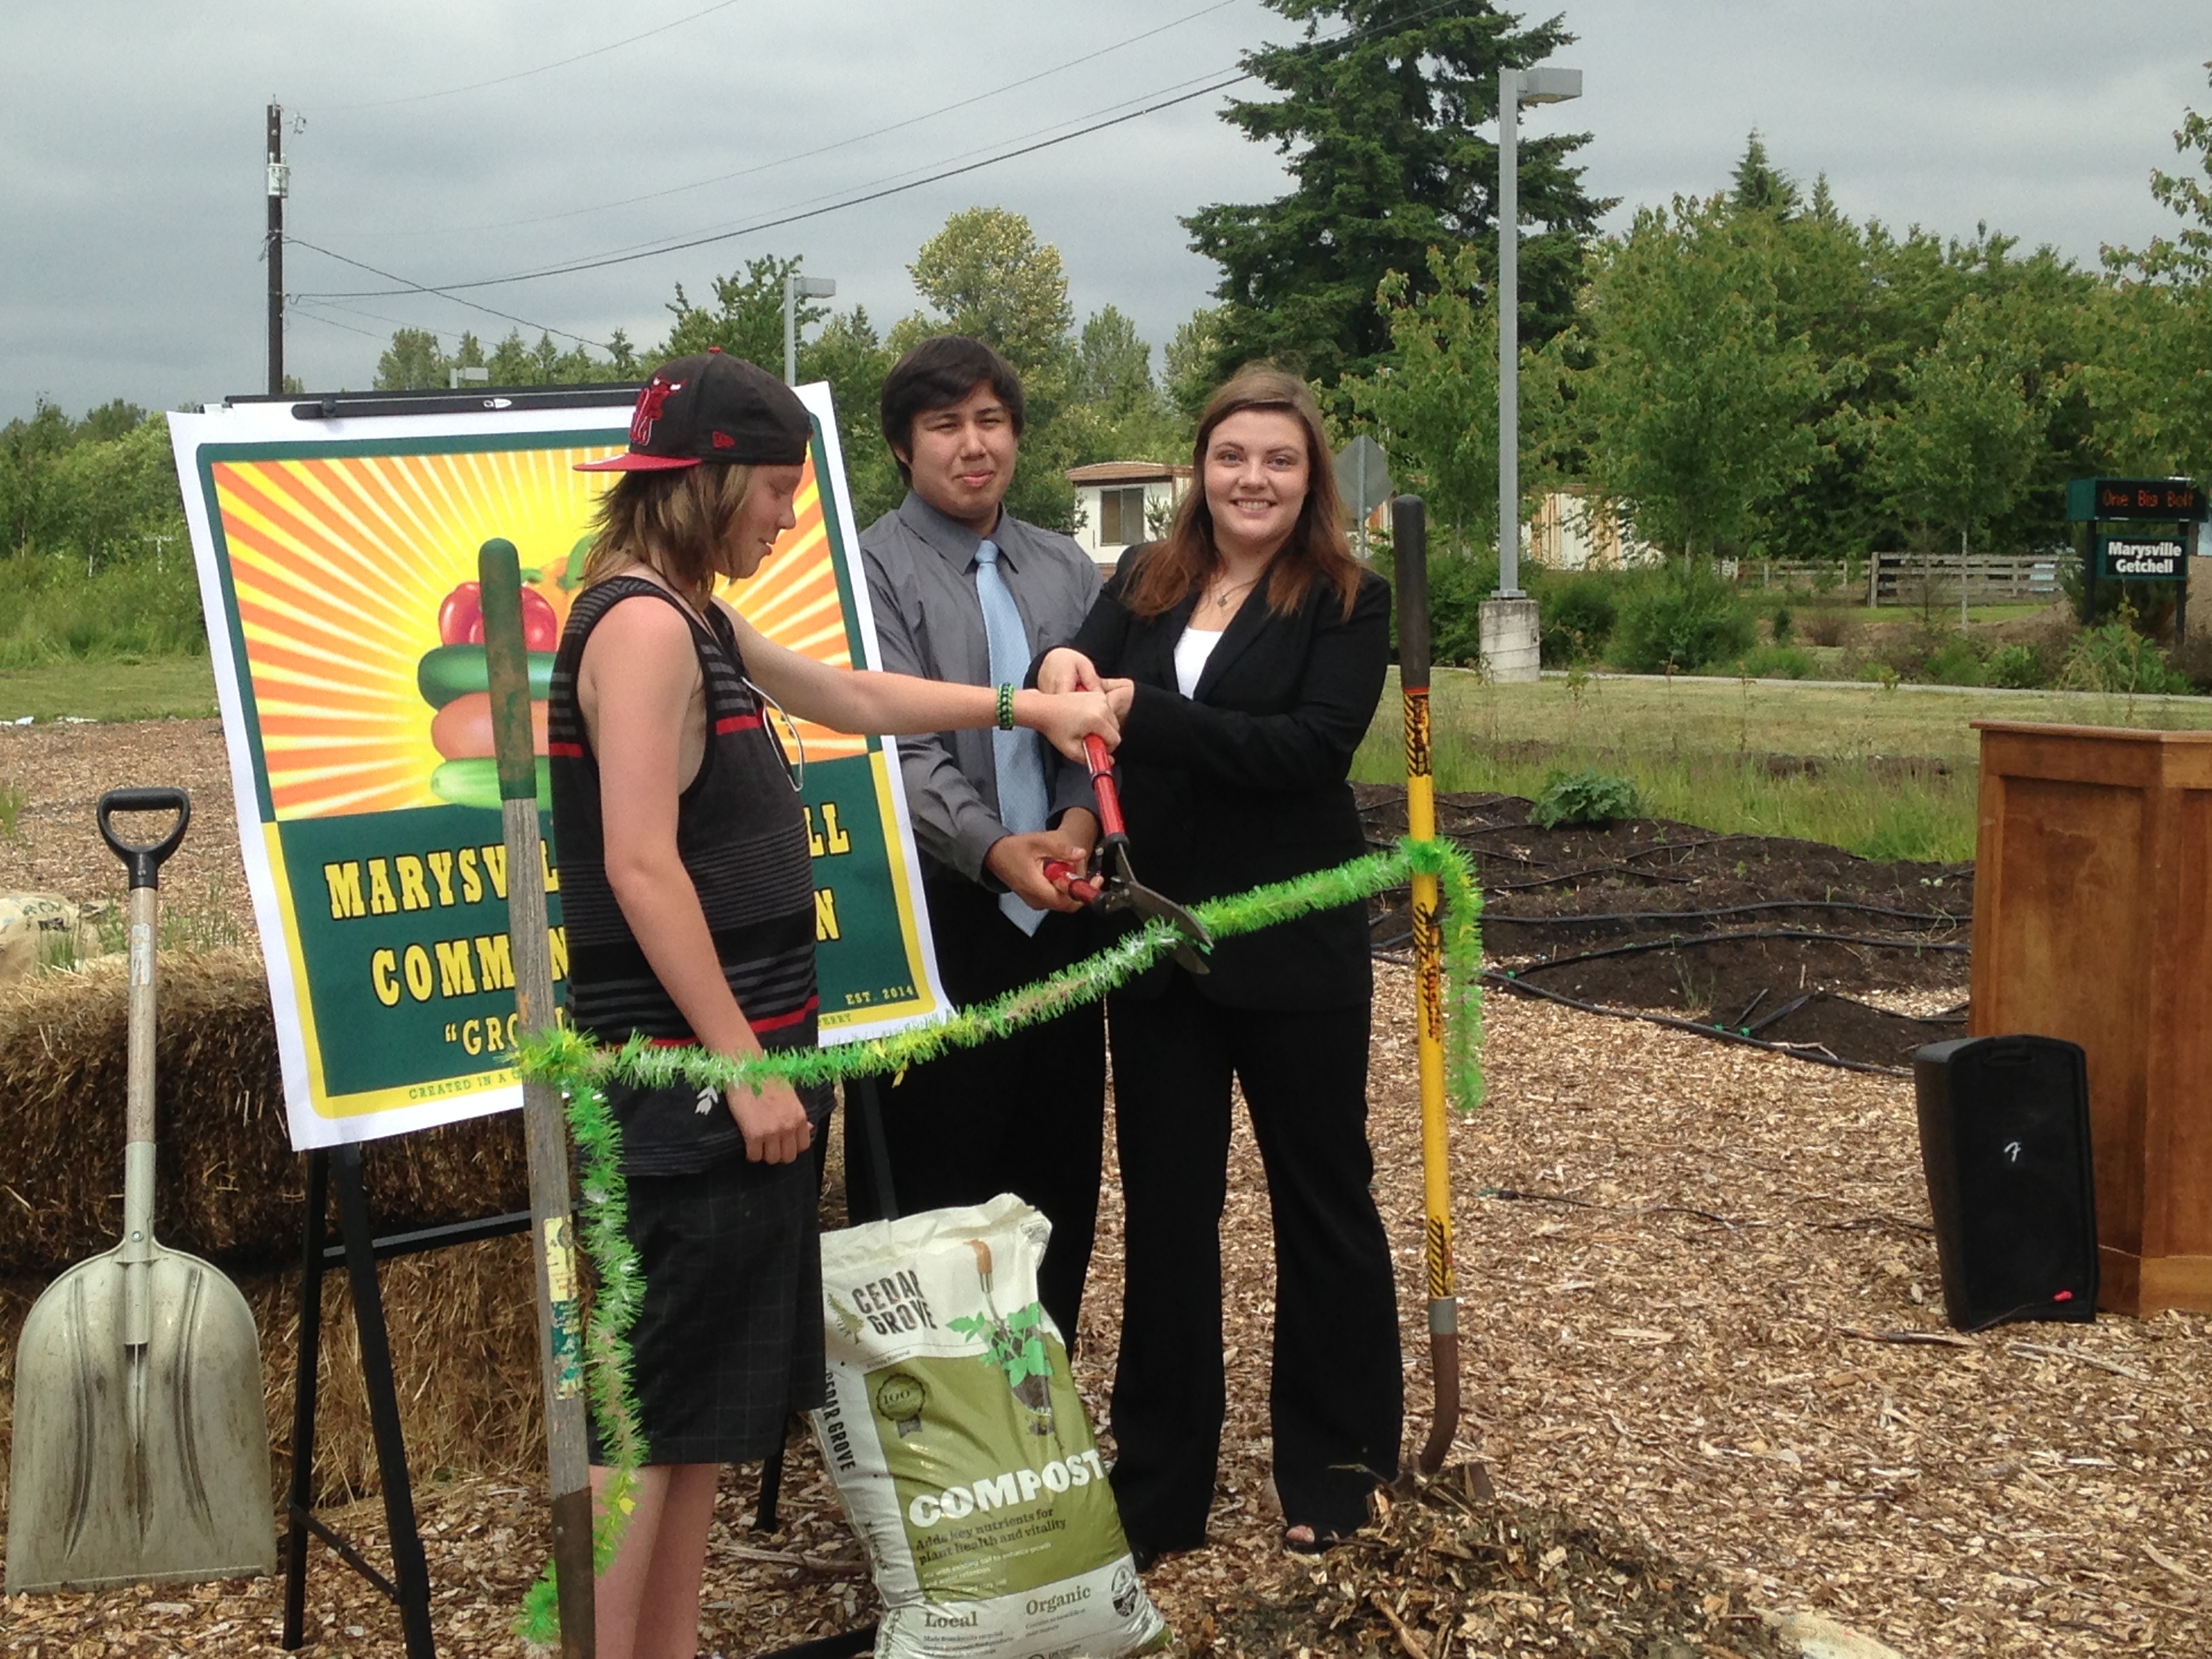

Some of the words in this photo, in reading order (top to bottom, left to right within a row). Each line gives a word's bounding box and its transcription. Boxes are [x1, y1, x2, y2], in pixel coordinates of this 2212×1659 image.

[2108, 541, 2182, 559] Marysville
[2116, 558, 2173, 573] Getchell
[882, 985, 914, 1000] 2014
[409, 1080, 471, 1099] CREATED
[477, 1076, 491, 1088] IN
[499, 1073, 507, 1084] A
[867, 1299, 938, 1335] GROVE
[827, 1421, 856, 1472] GROVE
[909, 1449, 1105, 1528] COMPOST
[916, 1534, 948, 1551] Adds
[950, 1528, 973, 1540] key
[976, 1514, 1035, 1534] nutrients
[1036, 1508, 1054, 1520] for
[918, 1547, 953, 1566] plant
[954, 1536, 997, 1553] health
[1000, 1528, 1023, 1543] and
[1025, 1519, 1067, 1538] vitality
[1026, 1585, 1091, 1616] Organic
[924, 1611, 979, 1628] Local
